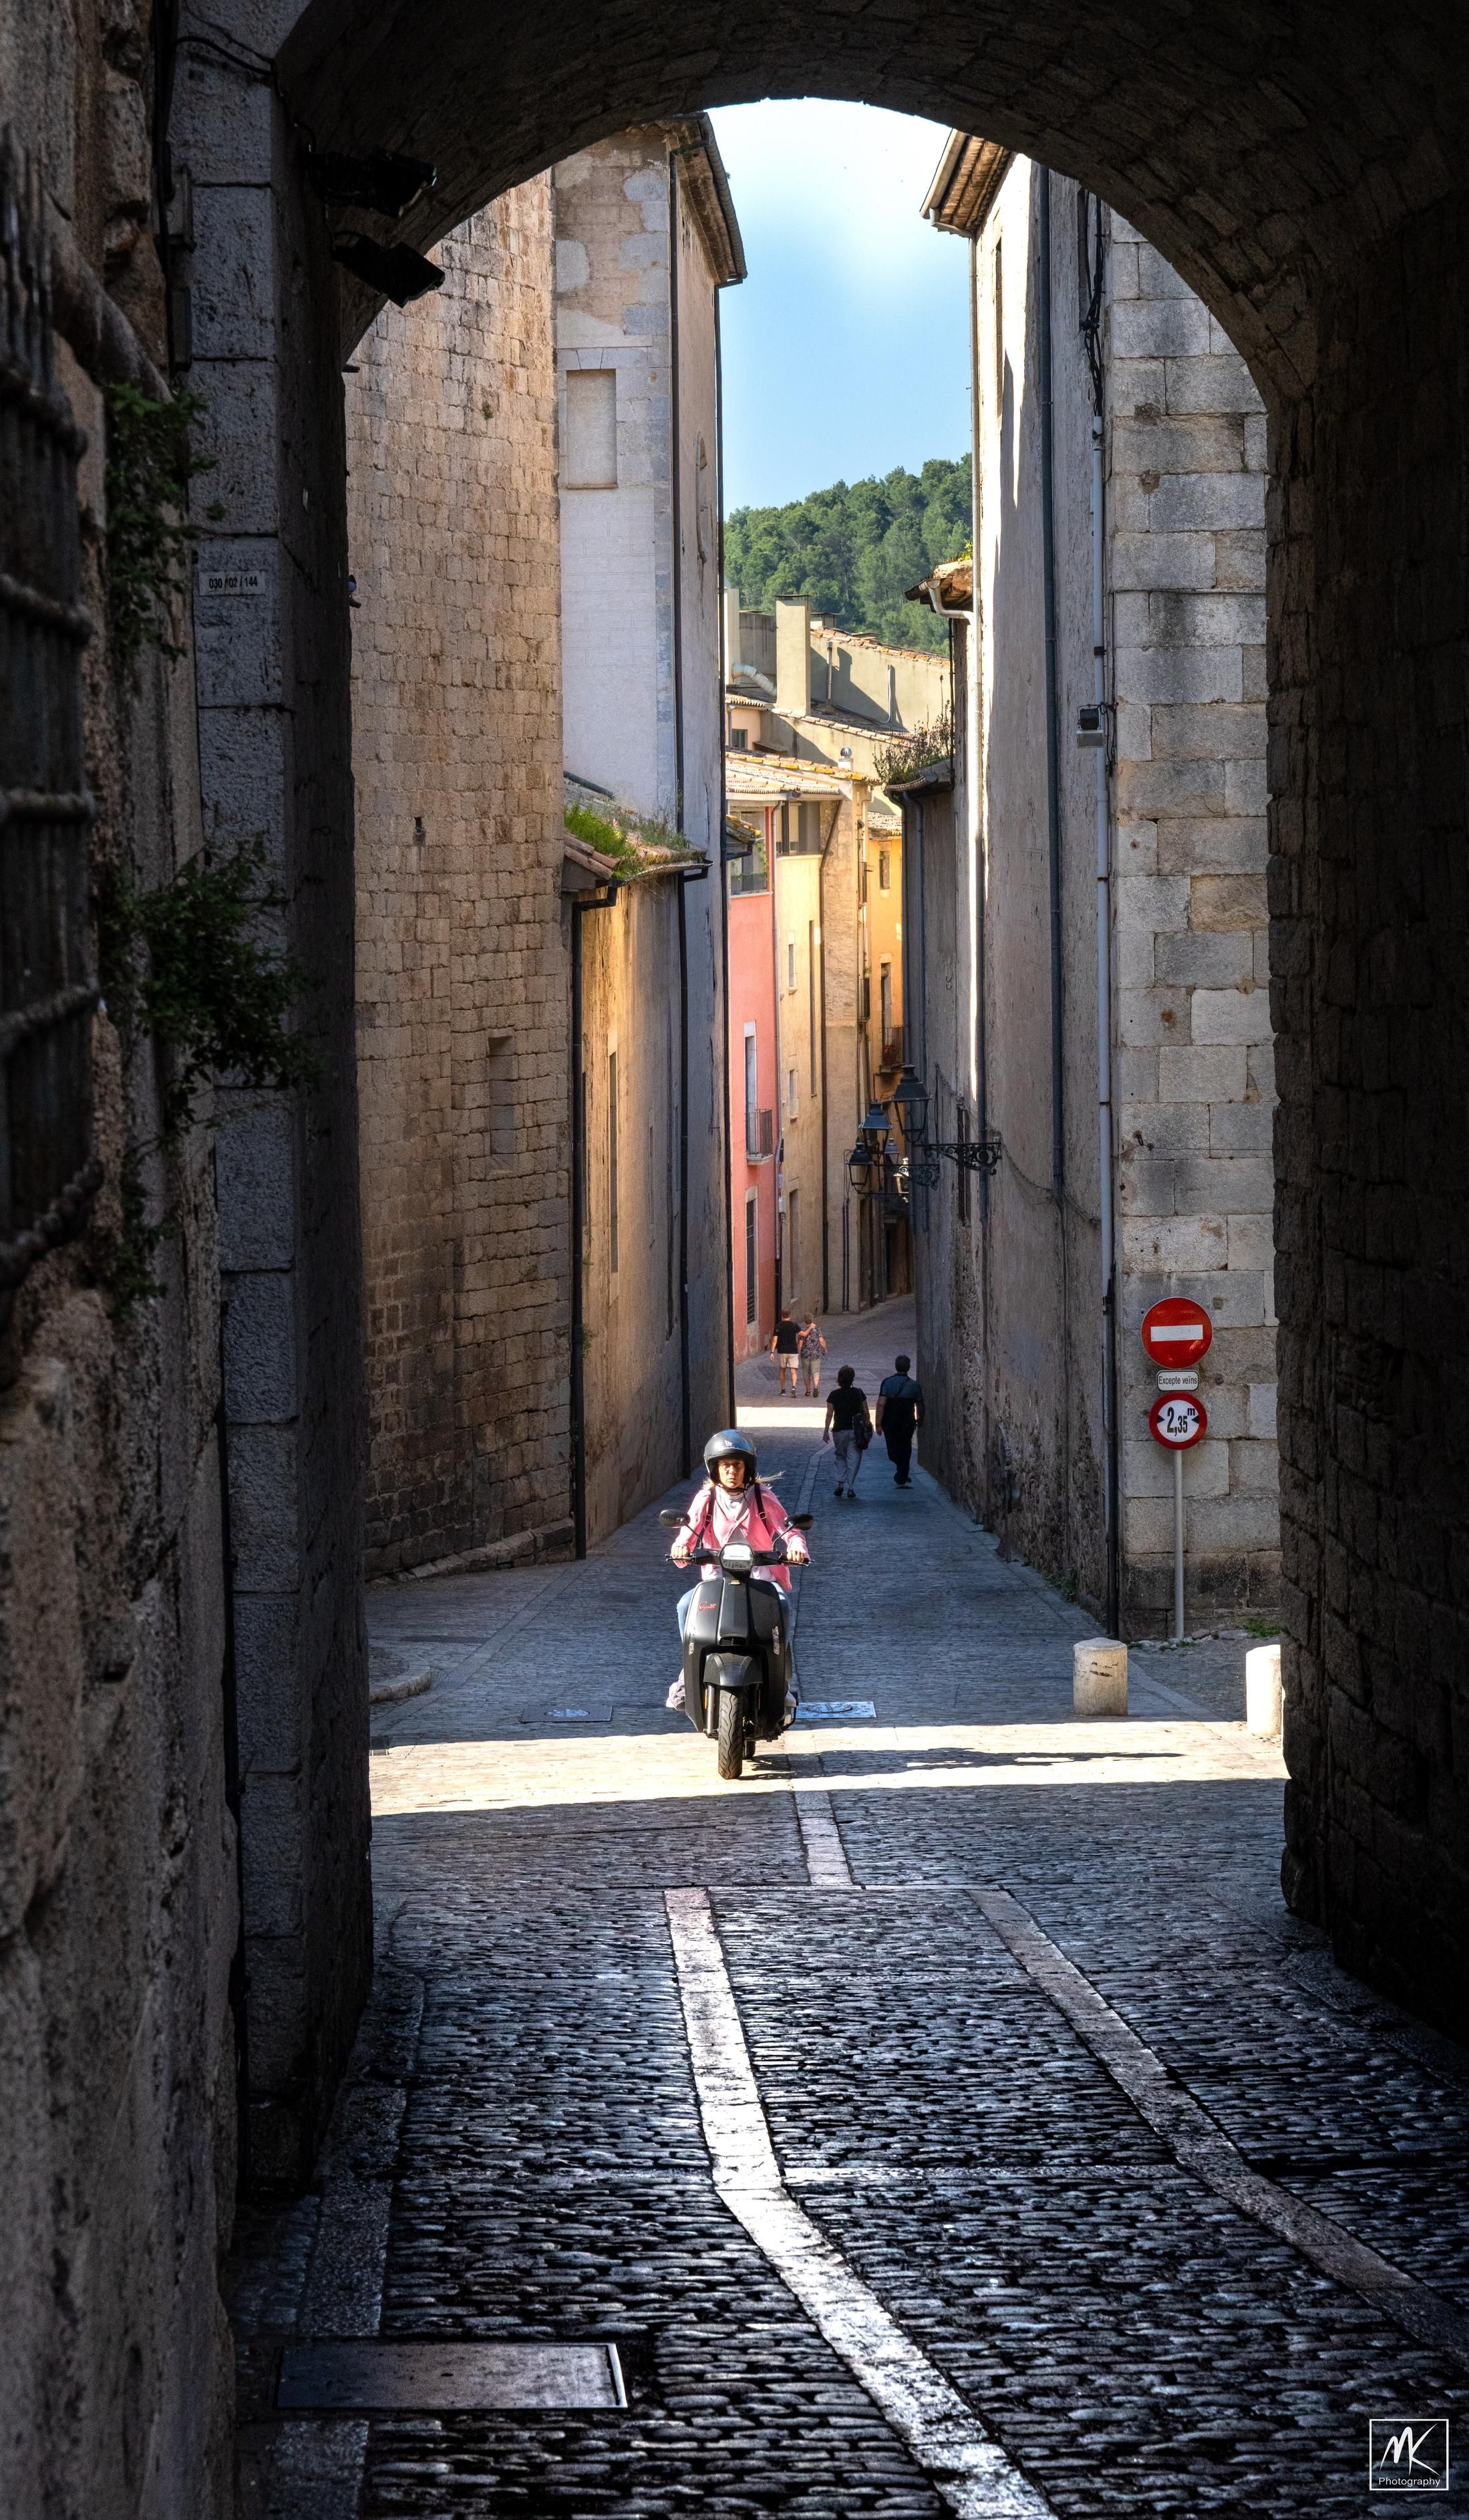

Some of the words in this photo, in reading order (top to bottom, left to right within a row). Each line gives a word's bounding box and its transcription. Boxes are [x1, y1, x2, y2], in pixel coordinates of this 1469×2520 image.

[1158, 1376, 1181, 1386] Excepte
[1182, 1376, 1198, 1385] veïns
[1166, 1407, 1188, 1437] 2,35
[1187, 1407, 1196, 1416] m
